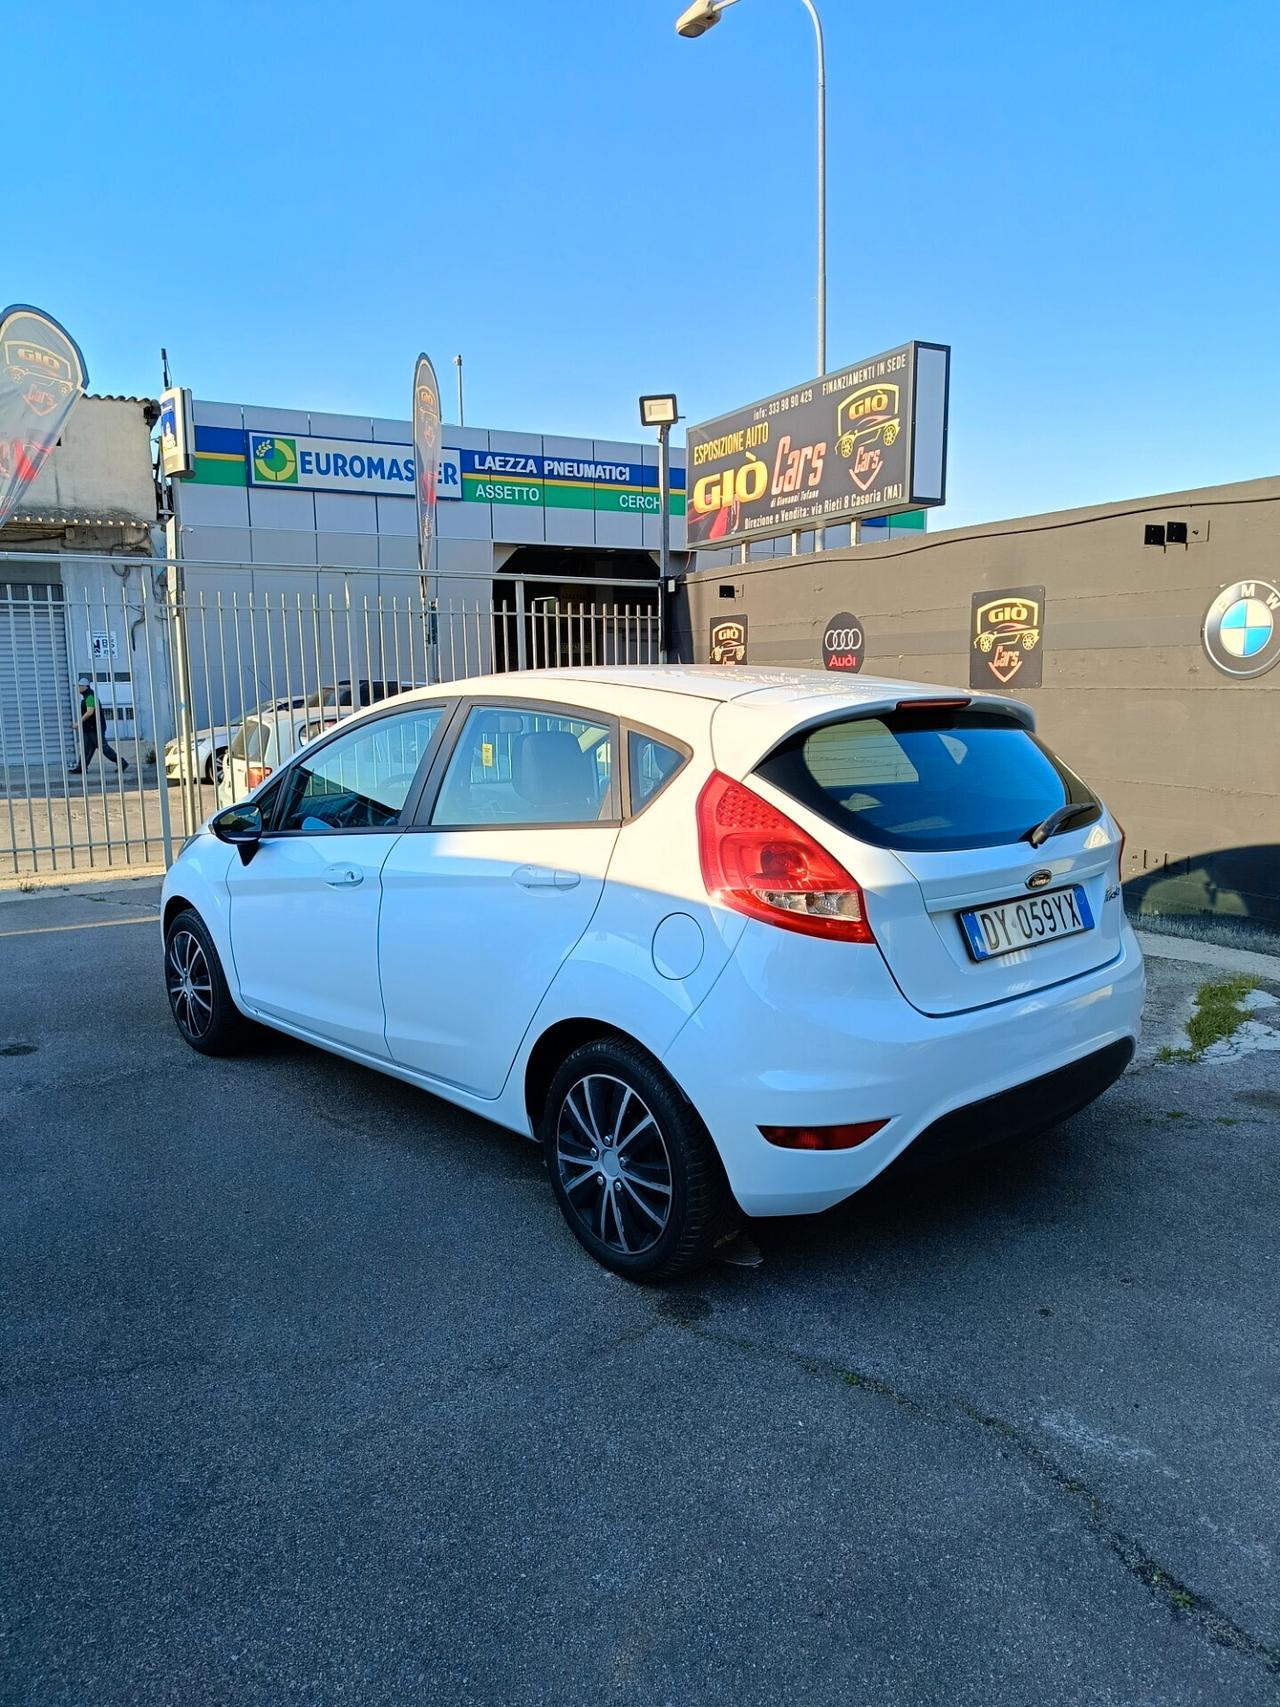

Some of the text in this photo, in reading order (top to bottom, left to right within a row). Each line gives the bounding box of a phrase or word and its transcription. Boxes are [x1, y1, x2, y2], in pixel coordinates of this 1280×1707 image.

[822, 353, 907, 396] FINANZIAMENTI IN SEDE
[753, 389, 813, 422] info: 333 98 90 429
[848, 389, 889, 420] GIÒ
[693, 421, 769, 466] ESPOSIZIONE AUTO
[299, 450, 459, 486] EUROMASR
[474, 454, 630, 481] LAEZZA PNEUMATICI
[693, 435, 827, 514] GIÒ Cars
[854, 445, 881, 474] Cars
[475, 483, 540, 501] ASSETTO
[619, 494, 661, 510] CERCH
[744, 513, 774, 530] Direzione
[774, 515, 780, 524] e
[780, 505, 810, 522] Vendita:
[811, 502, 822, 516] via
[823, 497, 843, 513] Rieti
[843, 495, 850, 509] 8
[851, 489, 881, 508] Casoria
[988, 602, 1028, 623] GIÒ
[828, 654, 857, 667] Audi
[993, 645, 1020, 667] Cars
[979, 892, 1081, 951] DY 059YX
